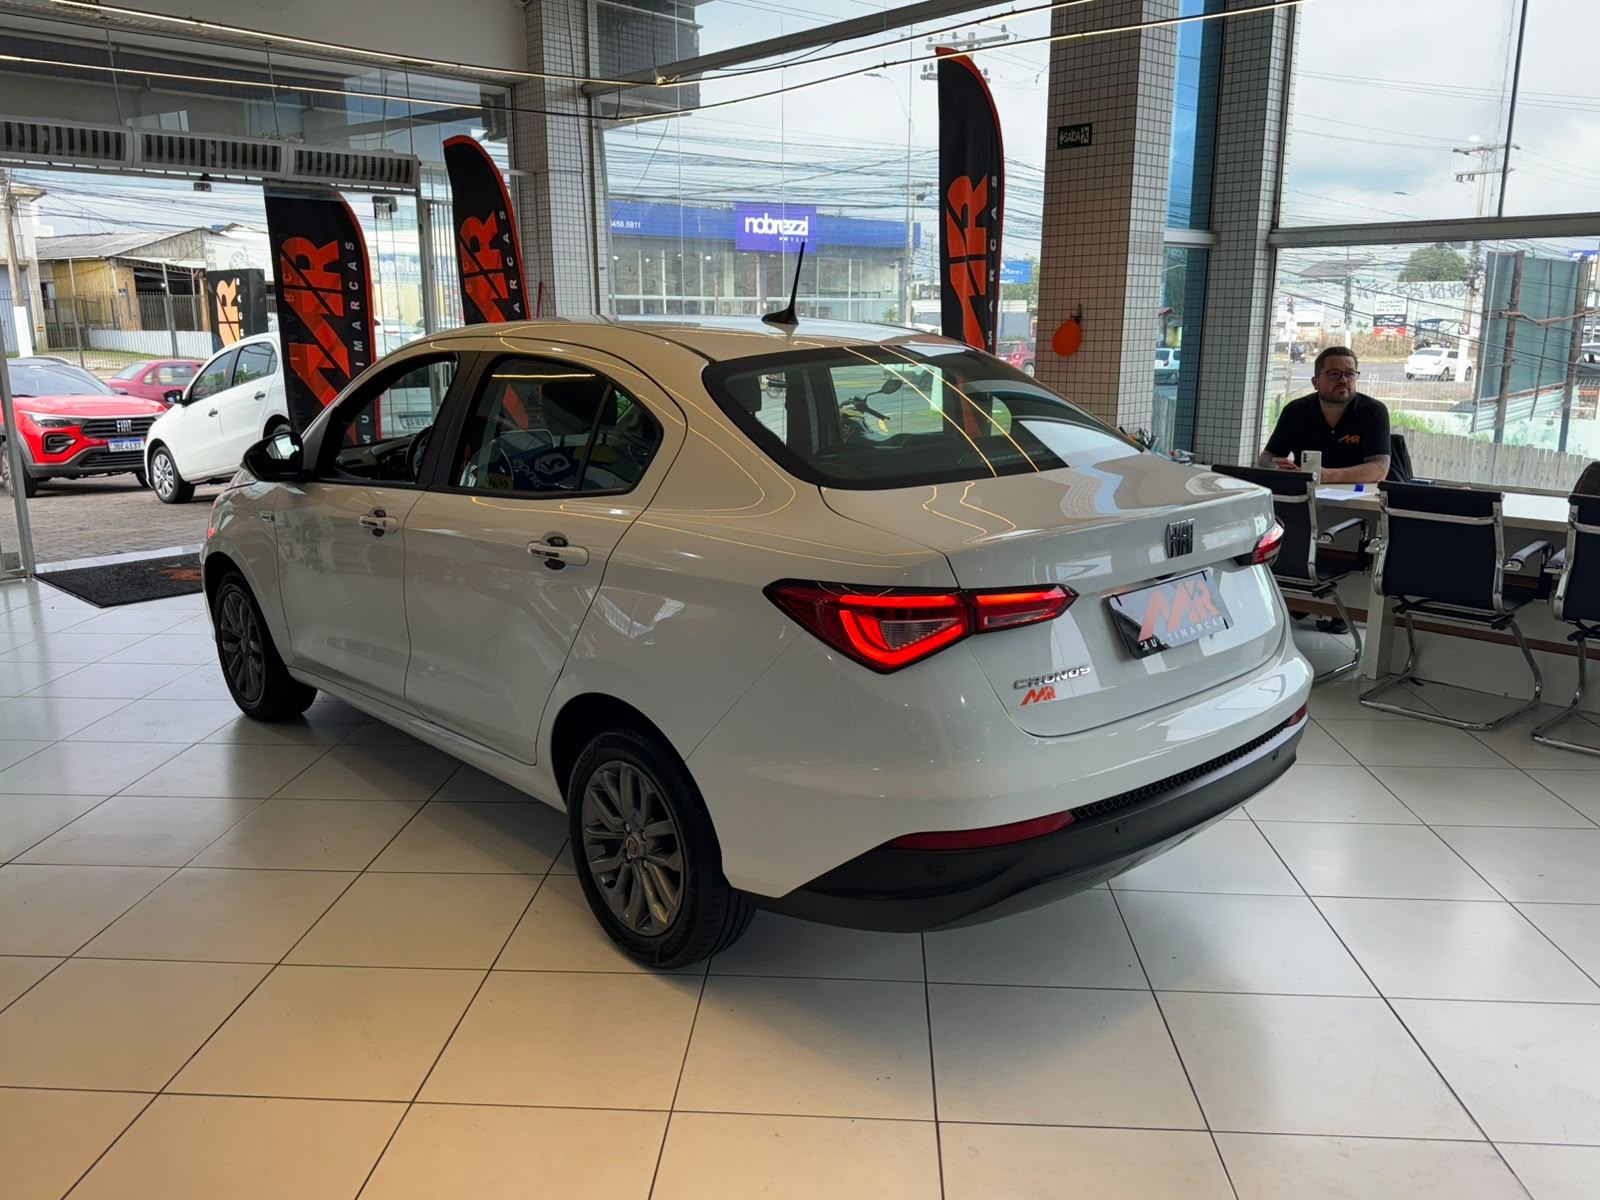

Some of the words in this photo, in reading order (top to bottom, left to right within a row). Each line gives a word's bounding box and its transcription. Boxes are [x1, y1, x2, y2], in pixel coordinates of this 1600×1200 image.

[744, 213, 809, 236] nobrezzi
[498, 210, 522, 314] ARCAS
[116, 419, 132, 433] FIAT
[1140, 617, 1225, 651] MULTIMARCAS
[1013, 664, 1091, 690] CRONOS
